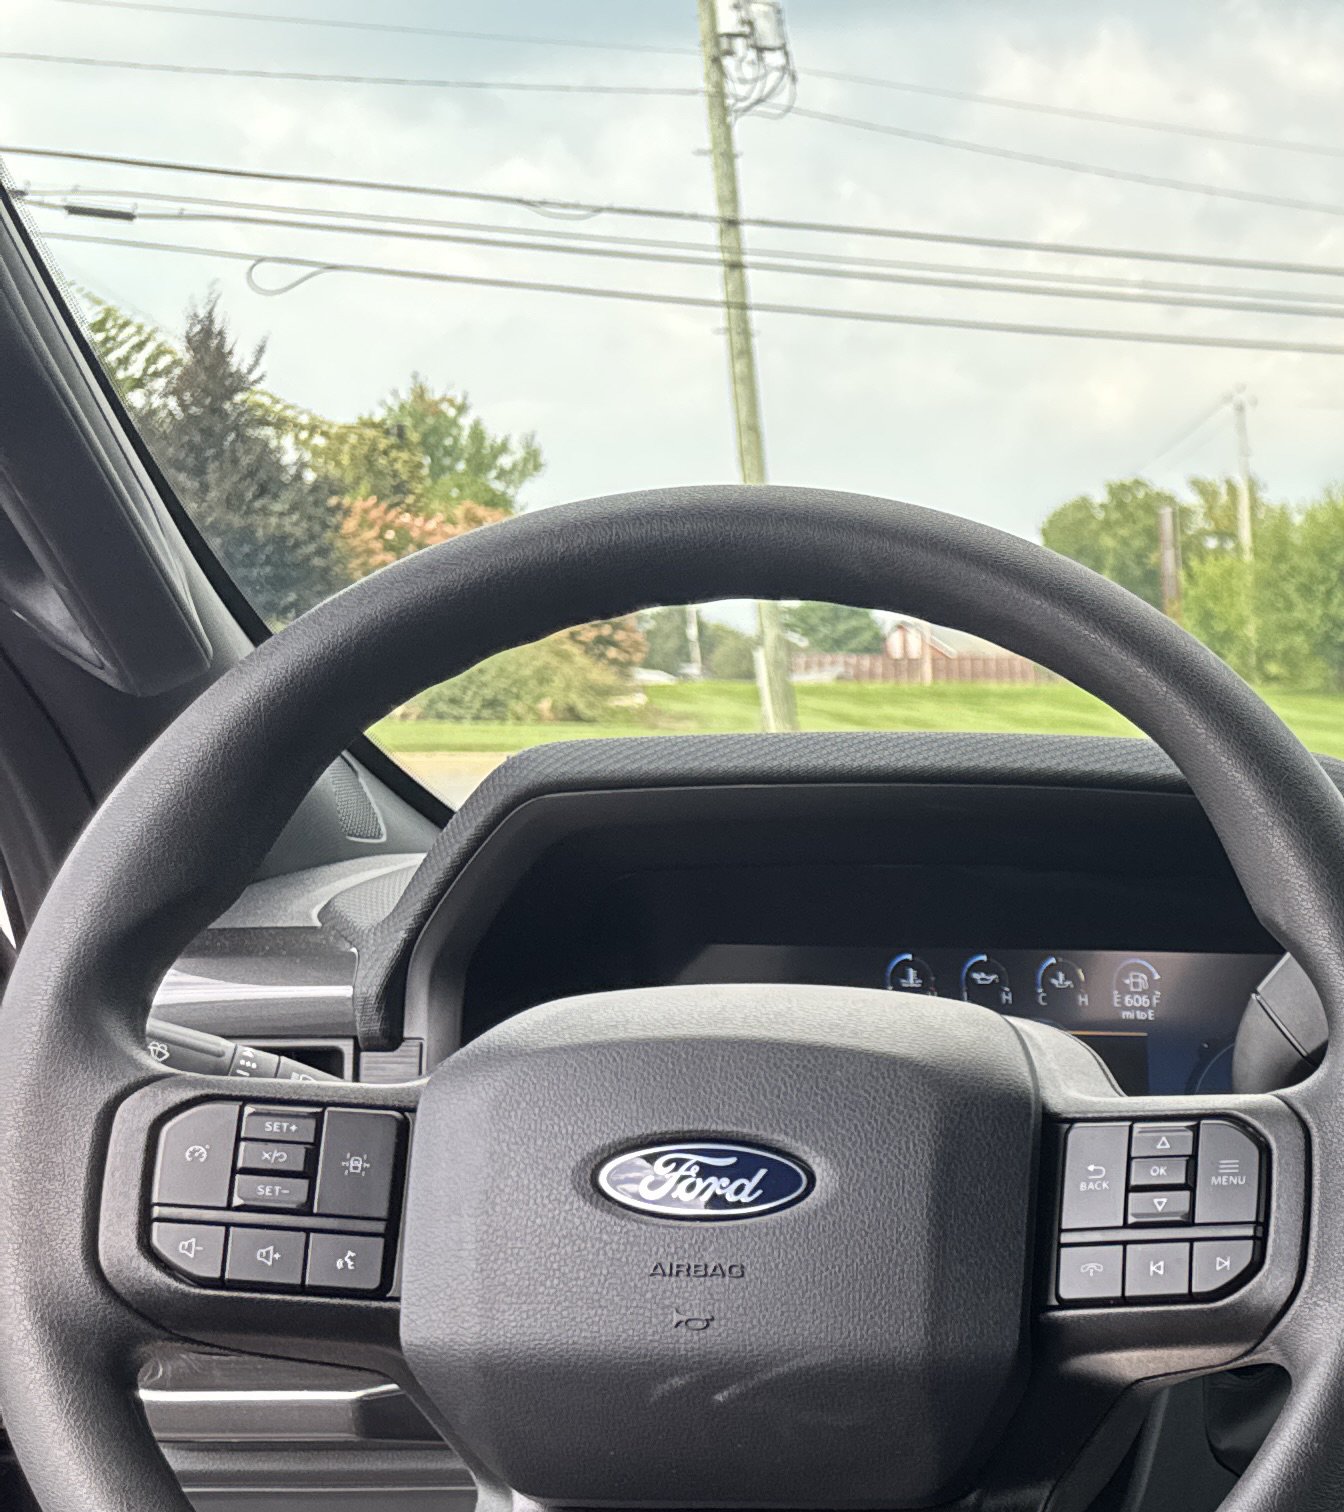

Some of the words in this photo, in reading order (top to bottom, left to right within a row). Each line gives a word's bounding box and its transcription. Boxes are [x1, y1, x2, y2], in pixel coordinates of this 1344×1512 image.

[1038, 994, 1047, 1005] C
[1078, 995, 1088, 1006] H
[1114, 995, 1121, 1007] E
[1124, 995, 1150, 1007] 606
[265, 1122, 298, 1132] SET+
[1150, 1166, 1167, 1176] OK
[639, 1153, 768, 1202] Ford
[1211, 1176, 1246, 1185] MENU
[1080, 1181, 1109, 1191] BACK
[650, 1262, 745, 1279] AIRBAG
